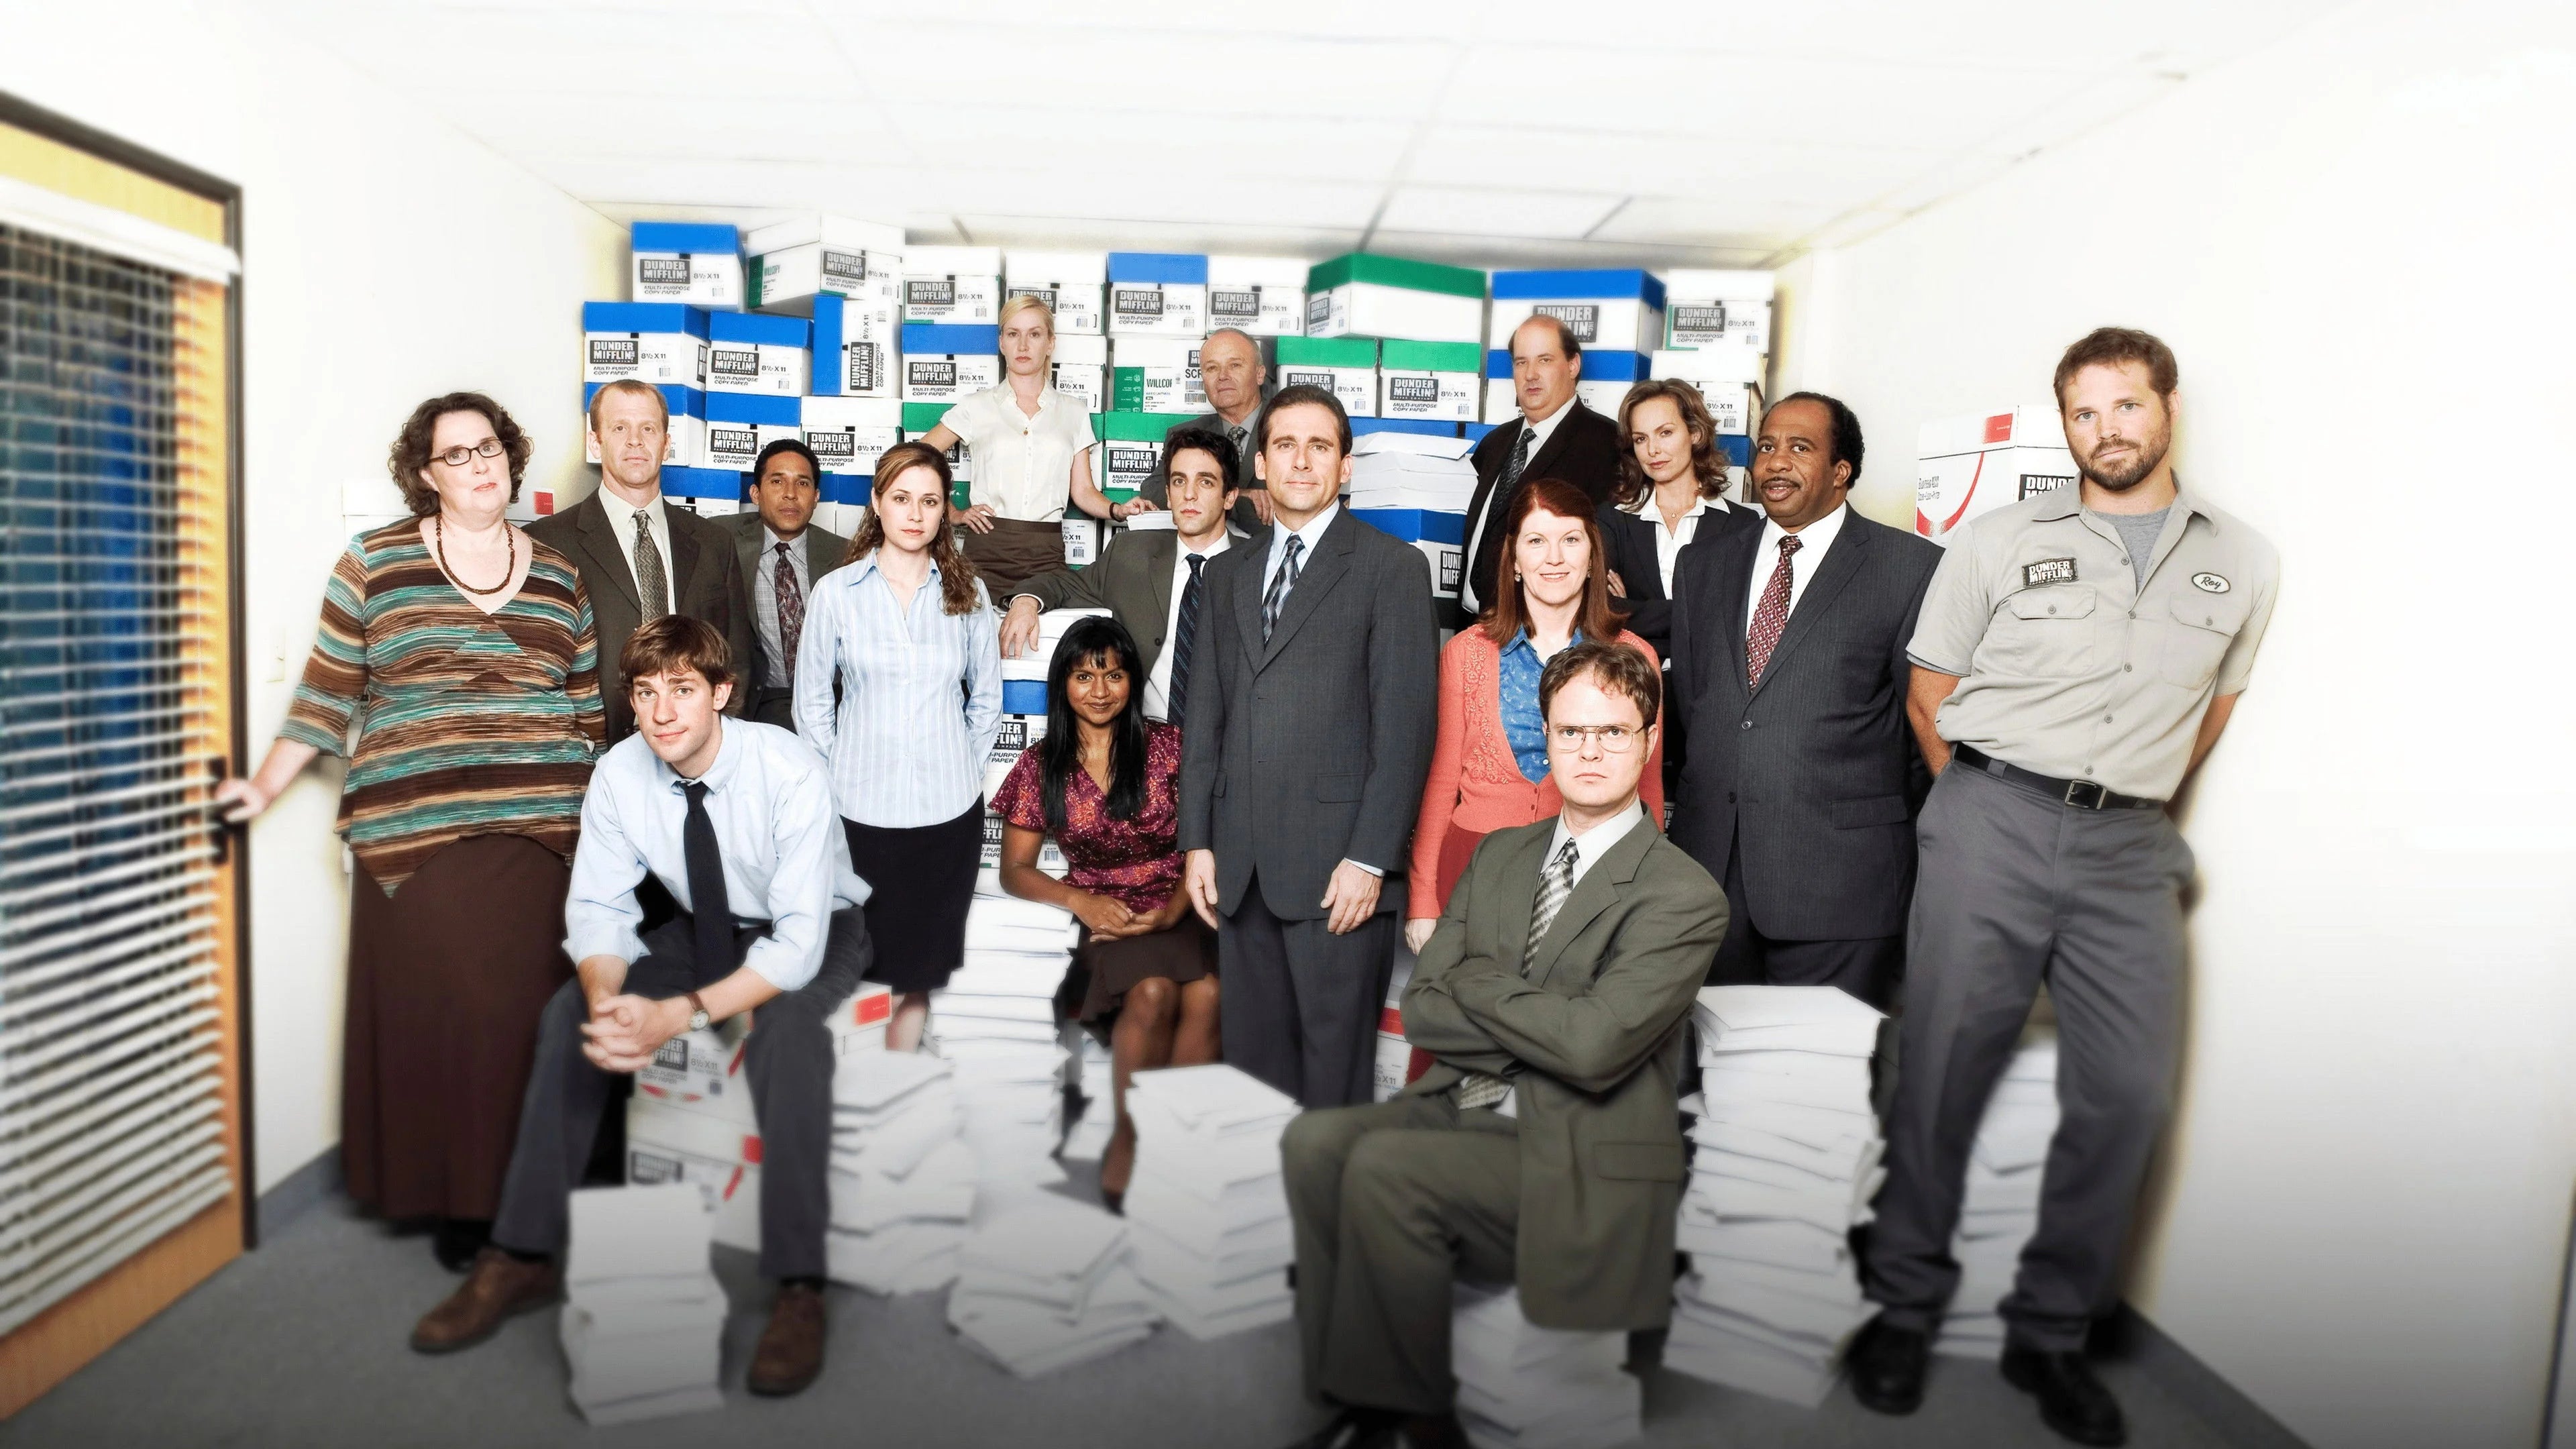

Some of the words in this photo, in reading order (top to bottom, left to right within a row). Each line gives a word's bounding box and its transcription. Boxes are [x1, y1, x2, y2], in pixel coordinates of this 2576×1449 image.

[644, 261, 684, 270] DUNDER
[912, 282, 950, 291] DUNDER
[1120, 291, 1159, 301] DUNDER
[1216, 294, 1255, 303] DUNDER
[1678, 309, 1721, 319] DUNDER
[594, 341, 633, 351] DUNDER
[716, 352, 755, 362] DUNDER
[852, 347, 860, 386] DUNDER
[913, 363, 951, 372] DUNDER
[1291, 374, 1331, 384] DUNDER
[1395, 379, 1434, 388] DUNDER
[715, 431, 753, 441] DUNDER
[811, 433, 850, 443] DUNDER
[811, 442, 847, 451] MIFFLIN
[1113, 451, 1152, 460] DUNDER
[1112, 460, 1149, 469] MIFFLIN
[2026, 476, 2073, 490] DUND
[1442, 552, 1462, 570] DUND
[2029, 561, 2070, 576] DUNDER
[1442, 568, 1460, 585] MIFF
[2201, 576, 2221, 590] Roy
[1002, 723, 1021, 734] DER
[665, 1039, 683, 1053] DER
[655, 1048, 680, 1064] FFLIN
[1382, 1075, 1388, 1083] X
